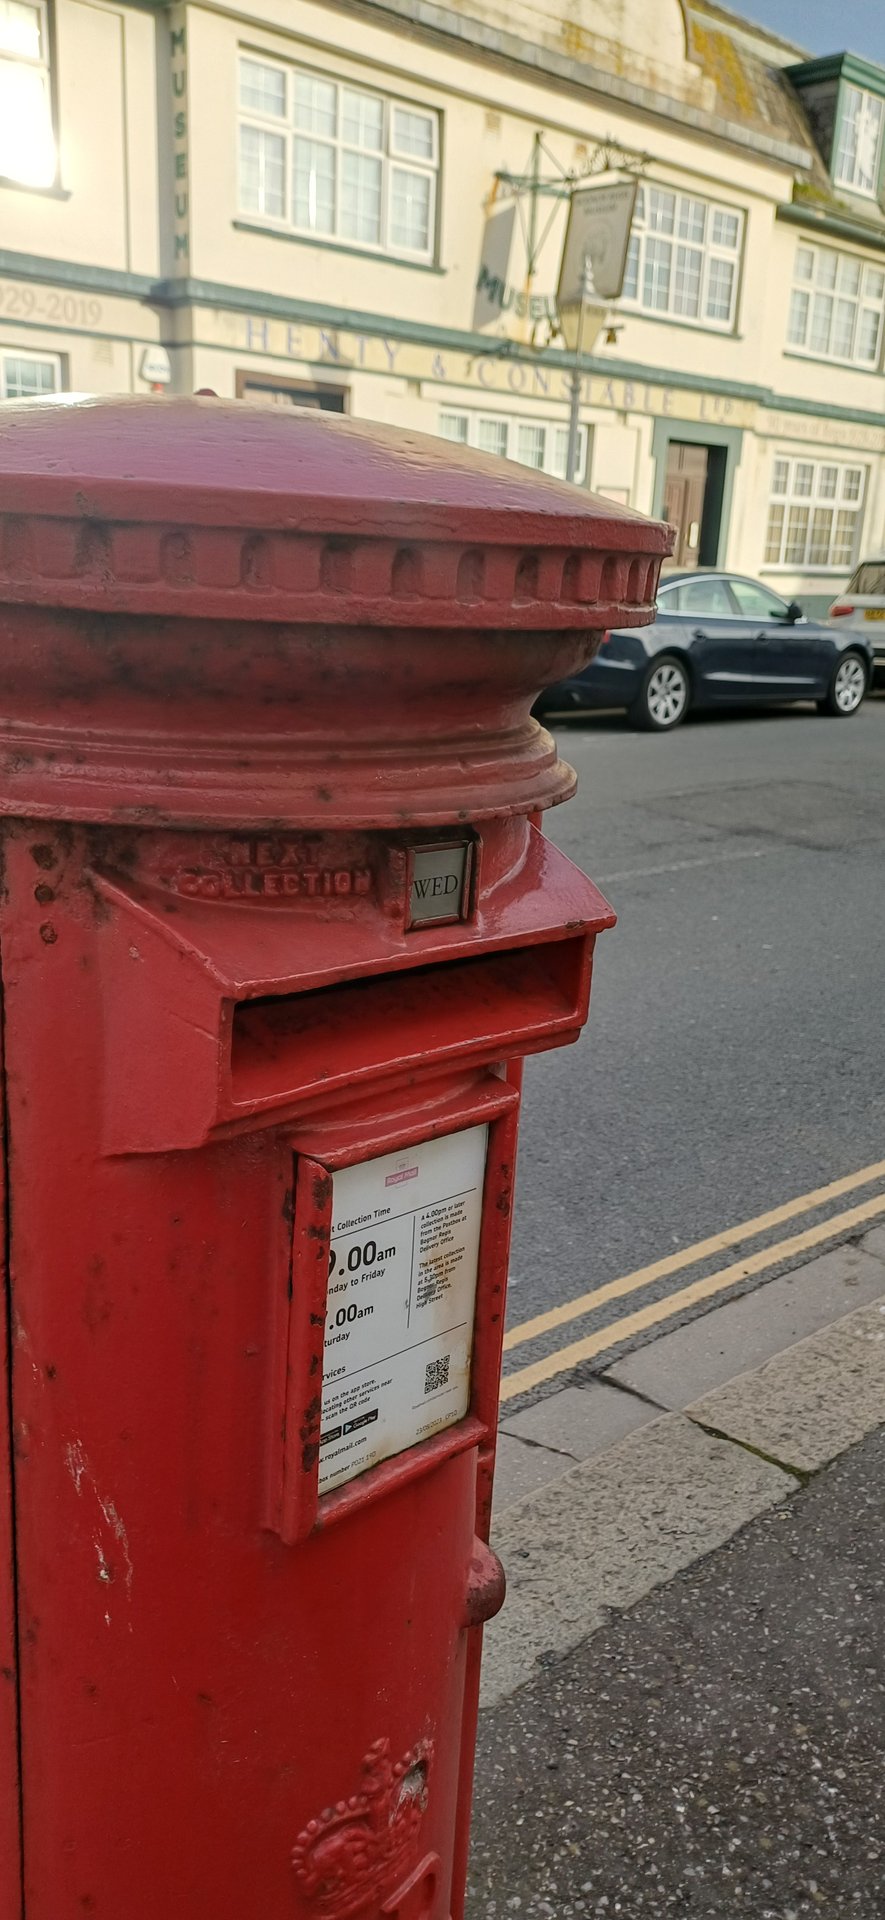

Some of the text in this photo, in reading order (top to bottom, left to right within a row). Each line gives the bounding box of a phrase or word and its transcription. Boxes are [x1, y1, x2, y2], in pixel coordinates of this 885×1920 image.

[170, 27, 189, 260] MUSEUM
[476, 264, 559, 321] MUSEU
[0, 285, 103, 326] 29-2019
[246, 318, 399, 371] HENTY
[432, 351, 447, 379] &
[478, 361, 673, 416] CONSTABLE
[231, 842, 319, 866] NEXT
[178, 871, 371, 897] COLLECTION
[414, 874, 459, 899] WED
[337, 1212, 372, 1231] Collection
[374, 1207, 391, 1219] Time
[421, 1217, 443, 1229] collection
[450, 1210, 463, 1218] made
[328, 1268, 386, 1295] nday to Friday
[326, 1304, 374, 1330] .00am
[324, 1331, 350, 1347] turday
[322, 1366, 346, 1381] rvices
[344, 1394, 358, 1405] other
[359, 1385, 379, 1398] services
[330, 1464, 350, 1479] number
